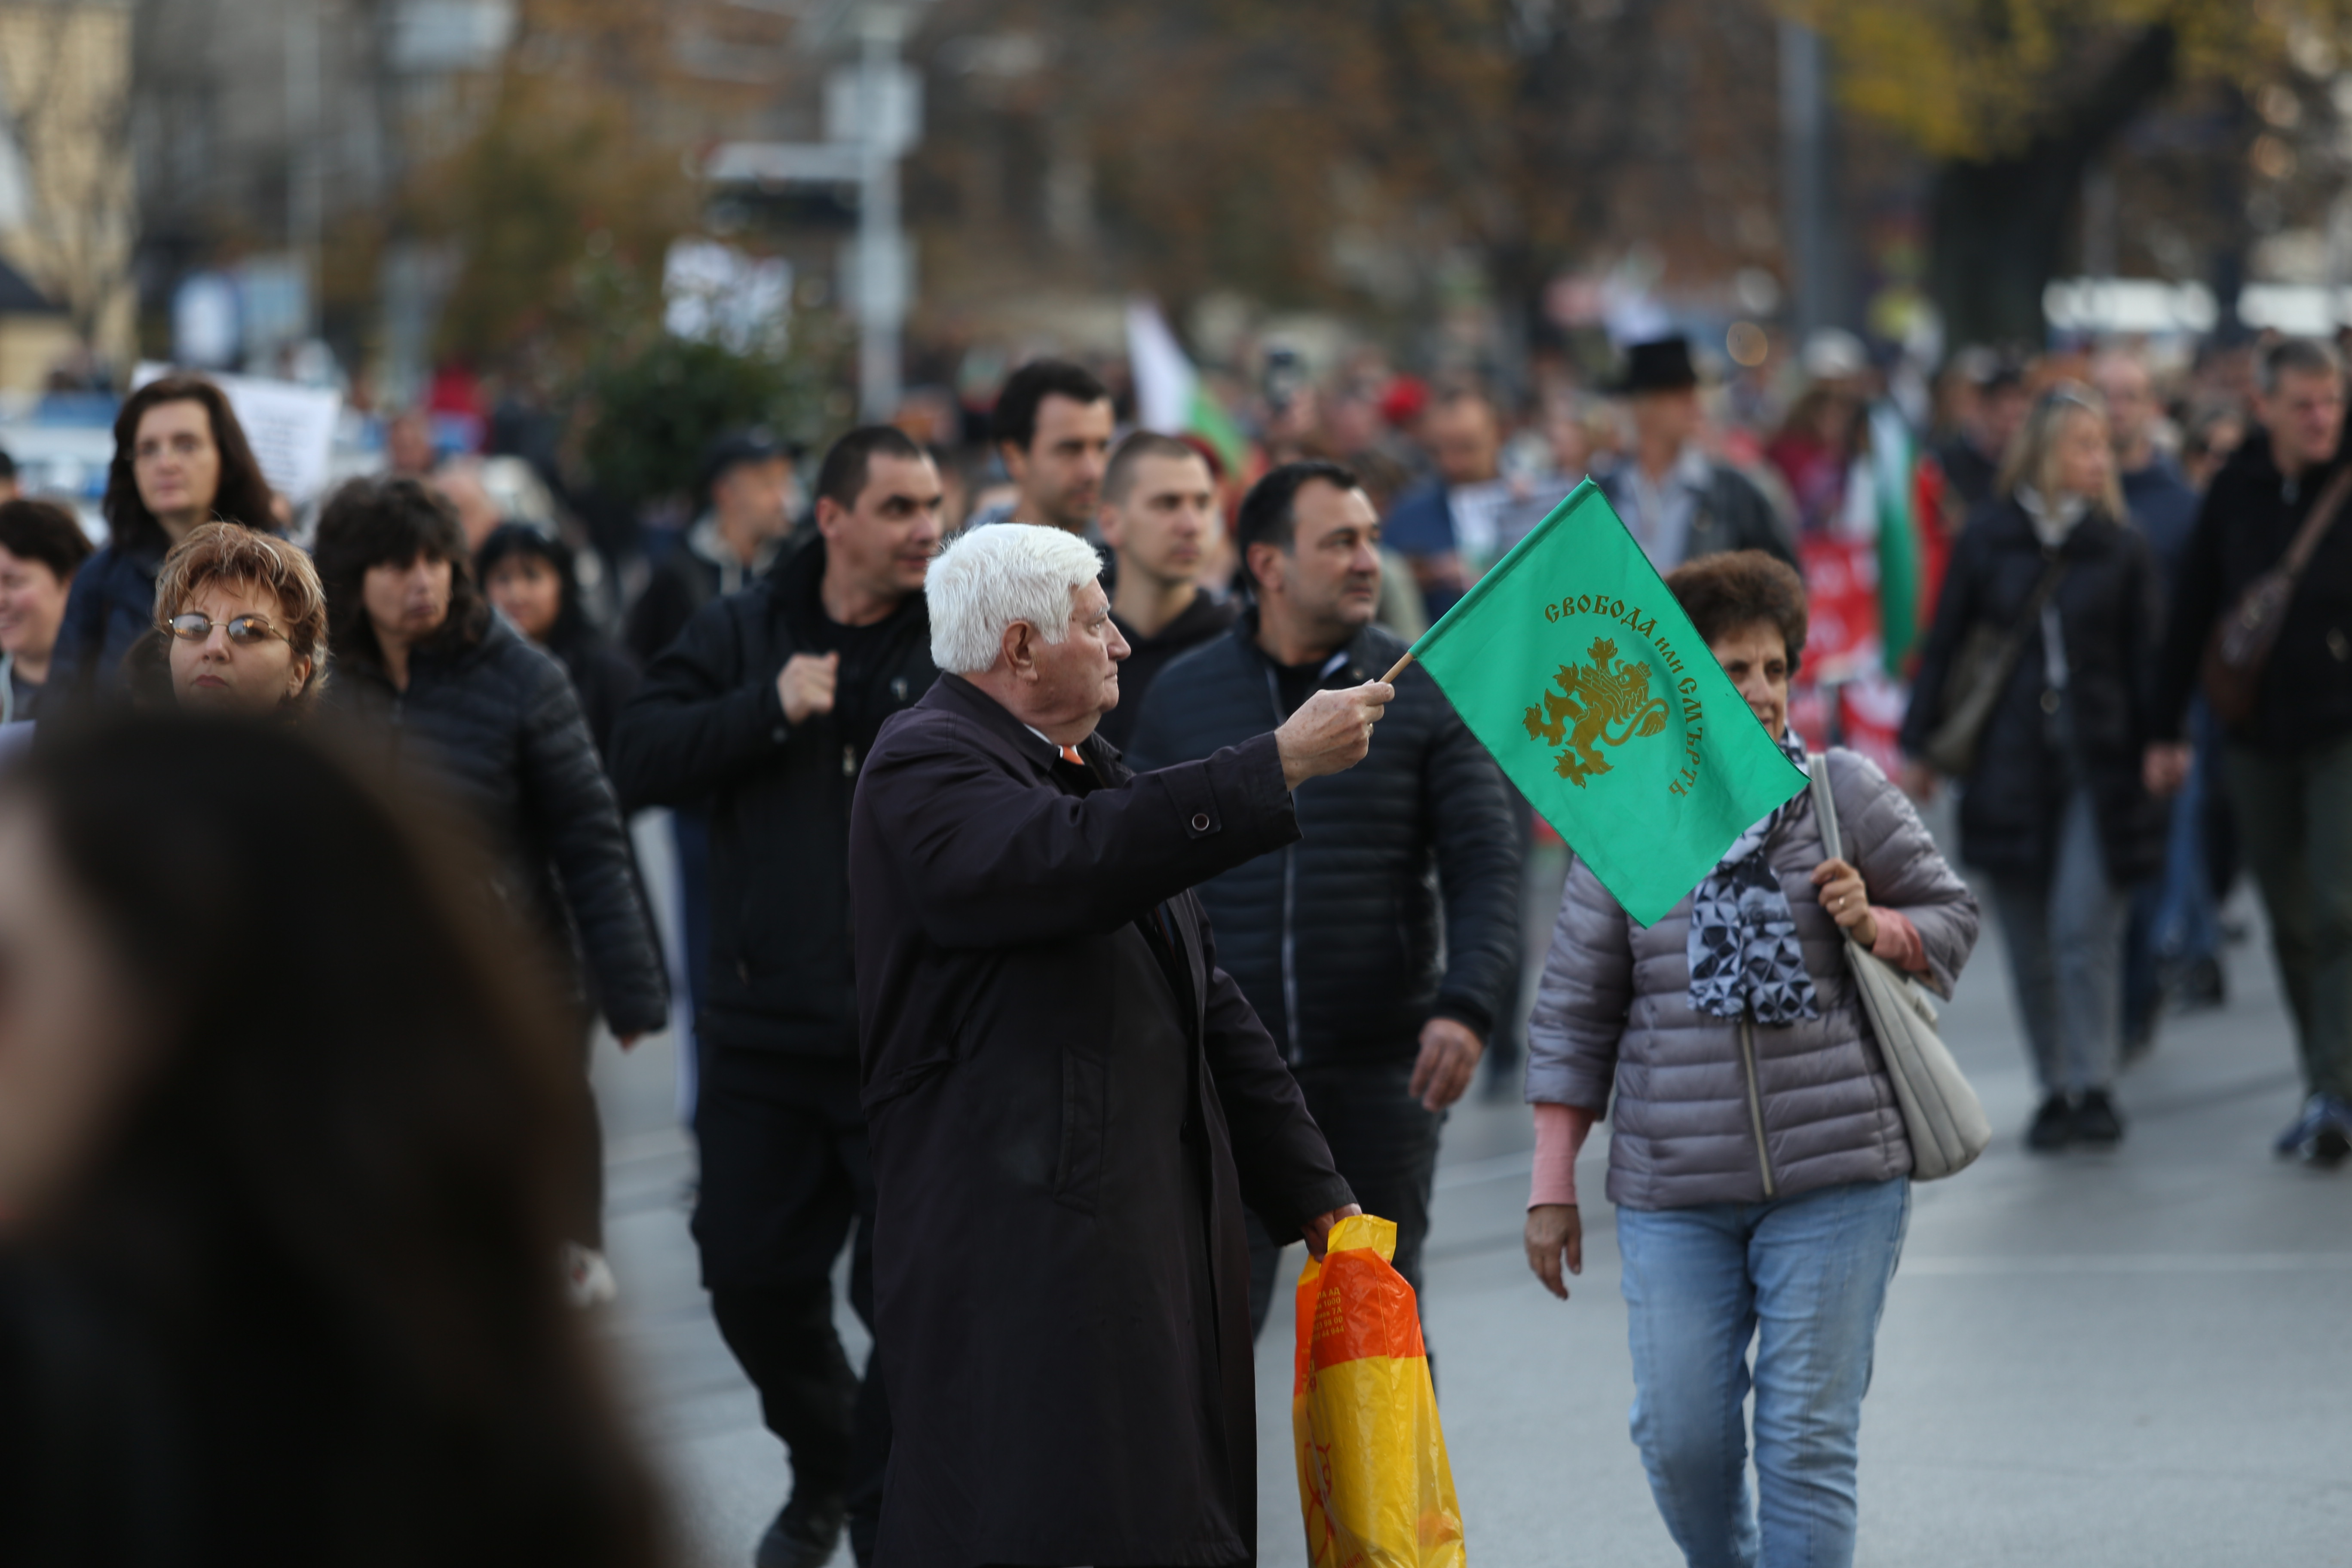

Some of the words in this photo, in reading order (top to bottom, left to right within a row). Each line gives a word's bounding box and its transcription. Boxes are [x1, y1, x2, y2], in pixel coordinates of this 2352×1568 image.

[1544, 594, 1657, 639] СВОБОДА
[1668, 677, 1703, 797] СМЪРТЬ
[1324, 1296, 1341, 1308] 1000
[1334, 1315, 1343, 1324] 00
